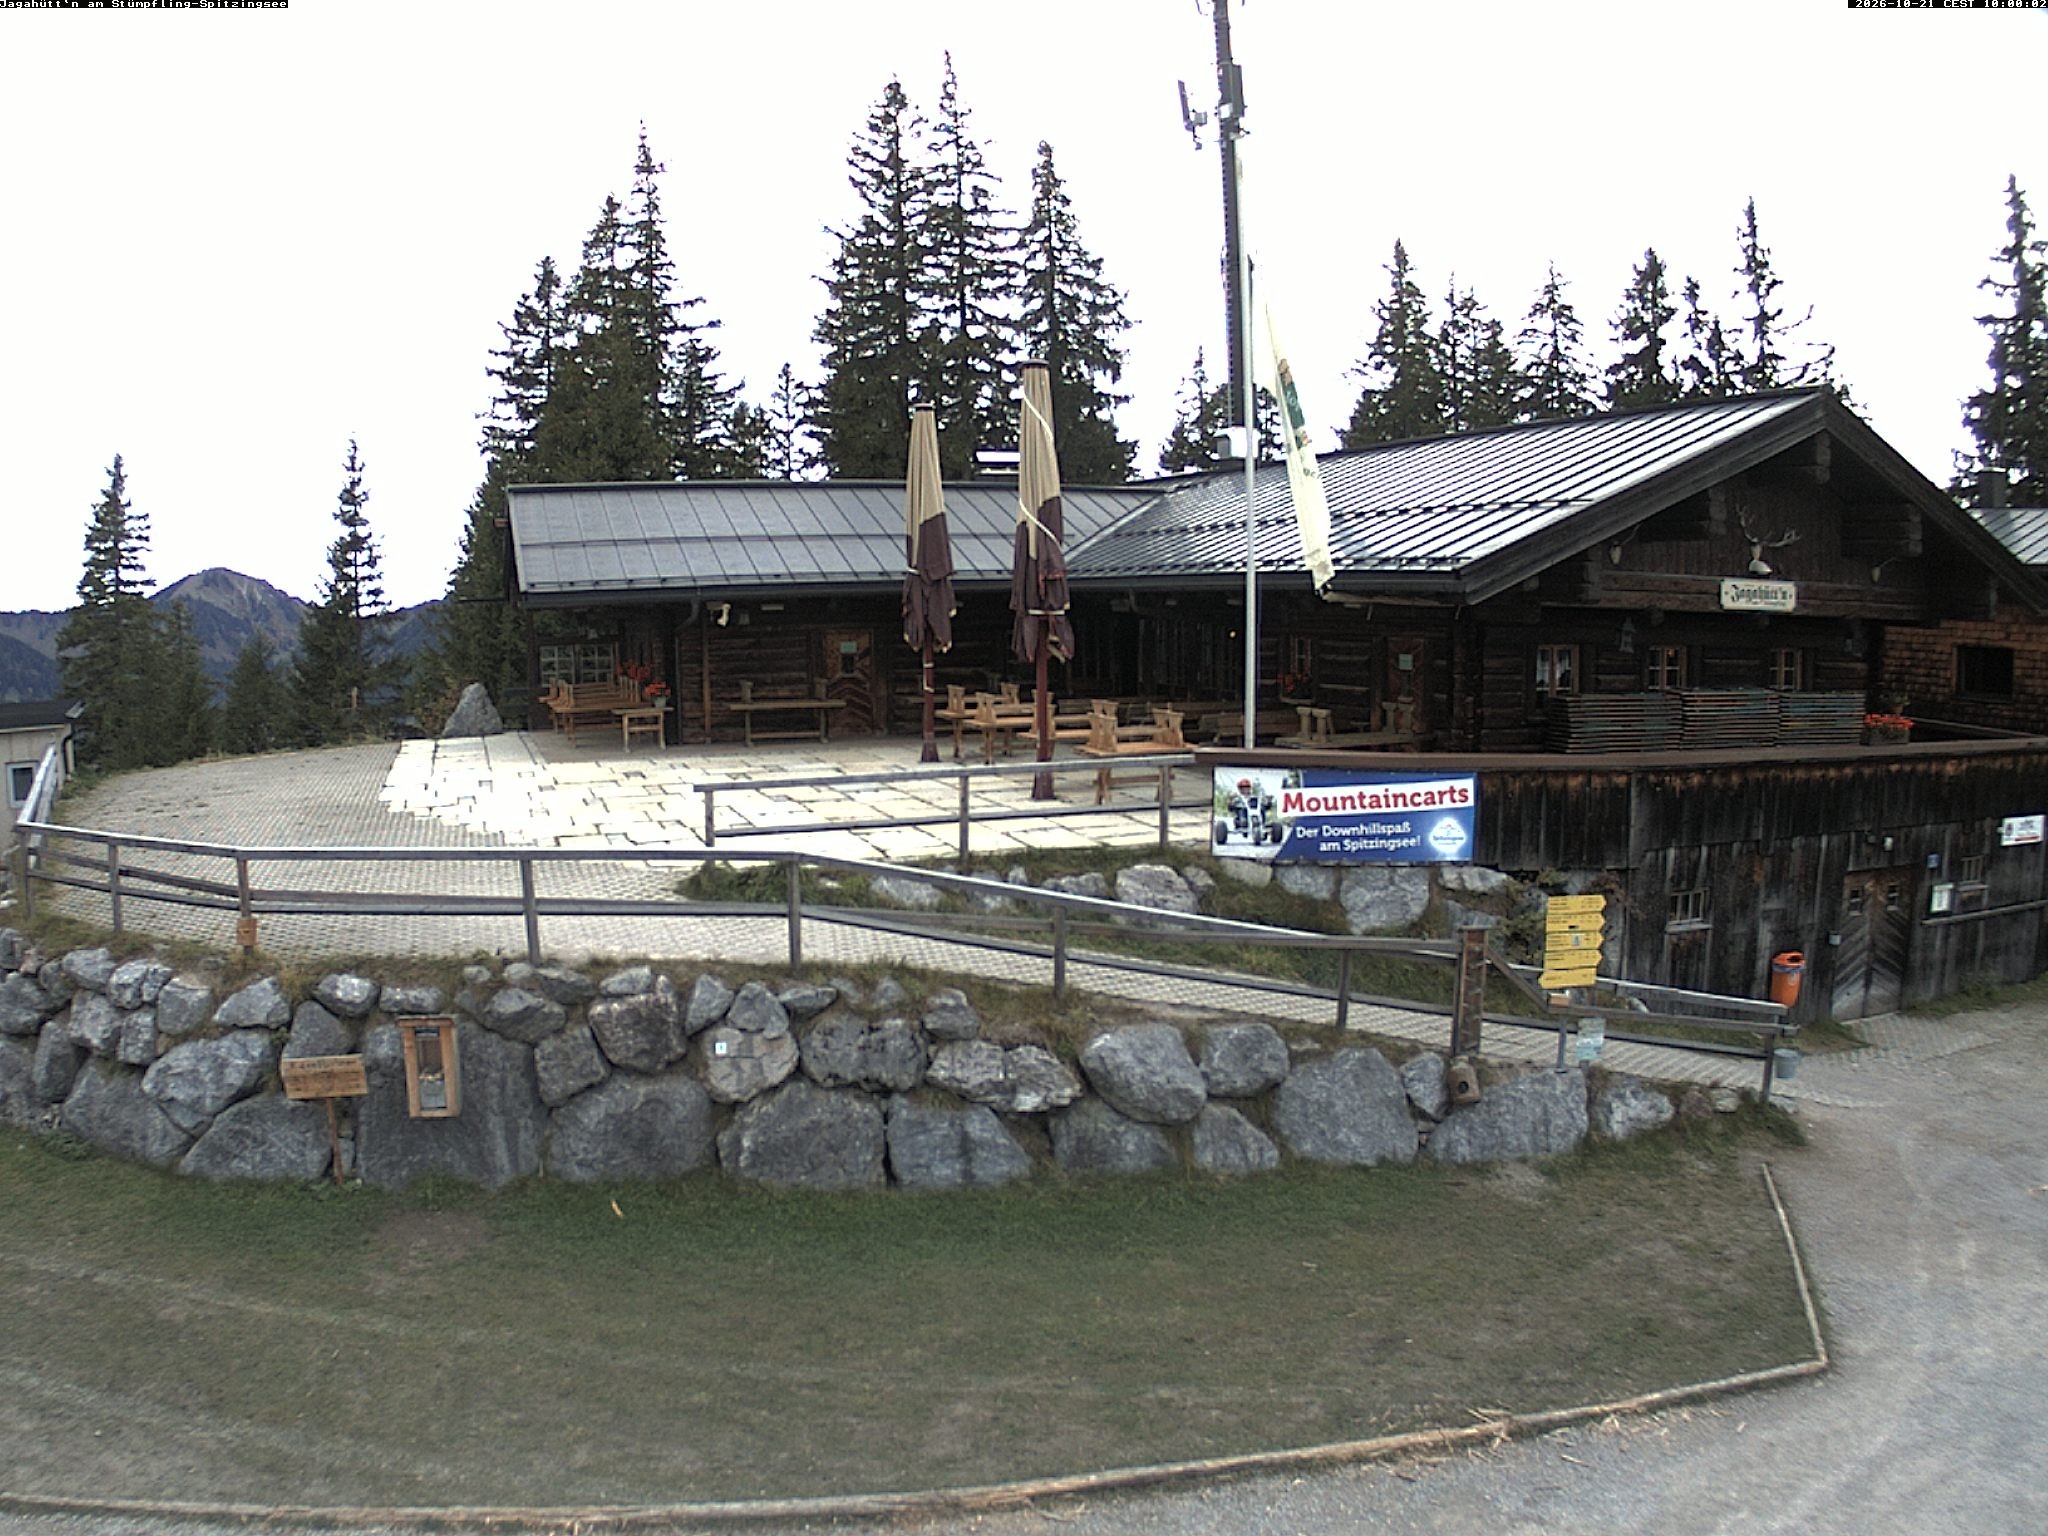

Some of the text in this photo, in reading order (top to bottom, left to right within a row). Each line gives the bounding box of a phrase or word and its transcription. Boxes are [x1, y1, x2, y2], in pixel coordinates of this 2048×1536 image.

[1282, 785, 1469, 813] Mountaincarts
[1295, 821, 1412, 838] Der Downhillspaß
[1320, 841, 1341, 852] am
[1342, 834, 1421, 853] Spitzingsee!
